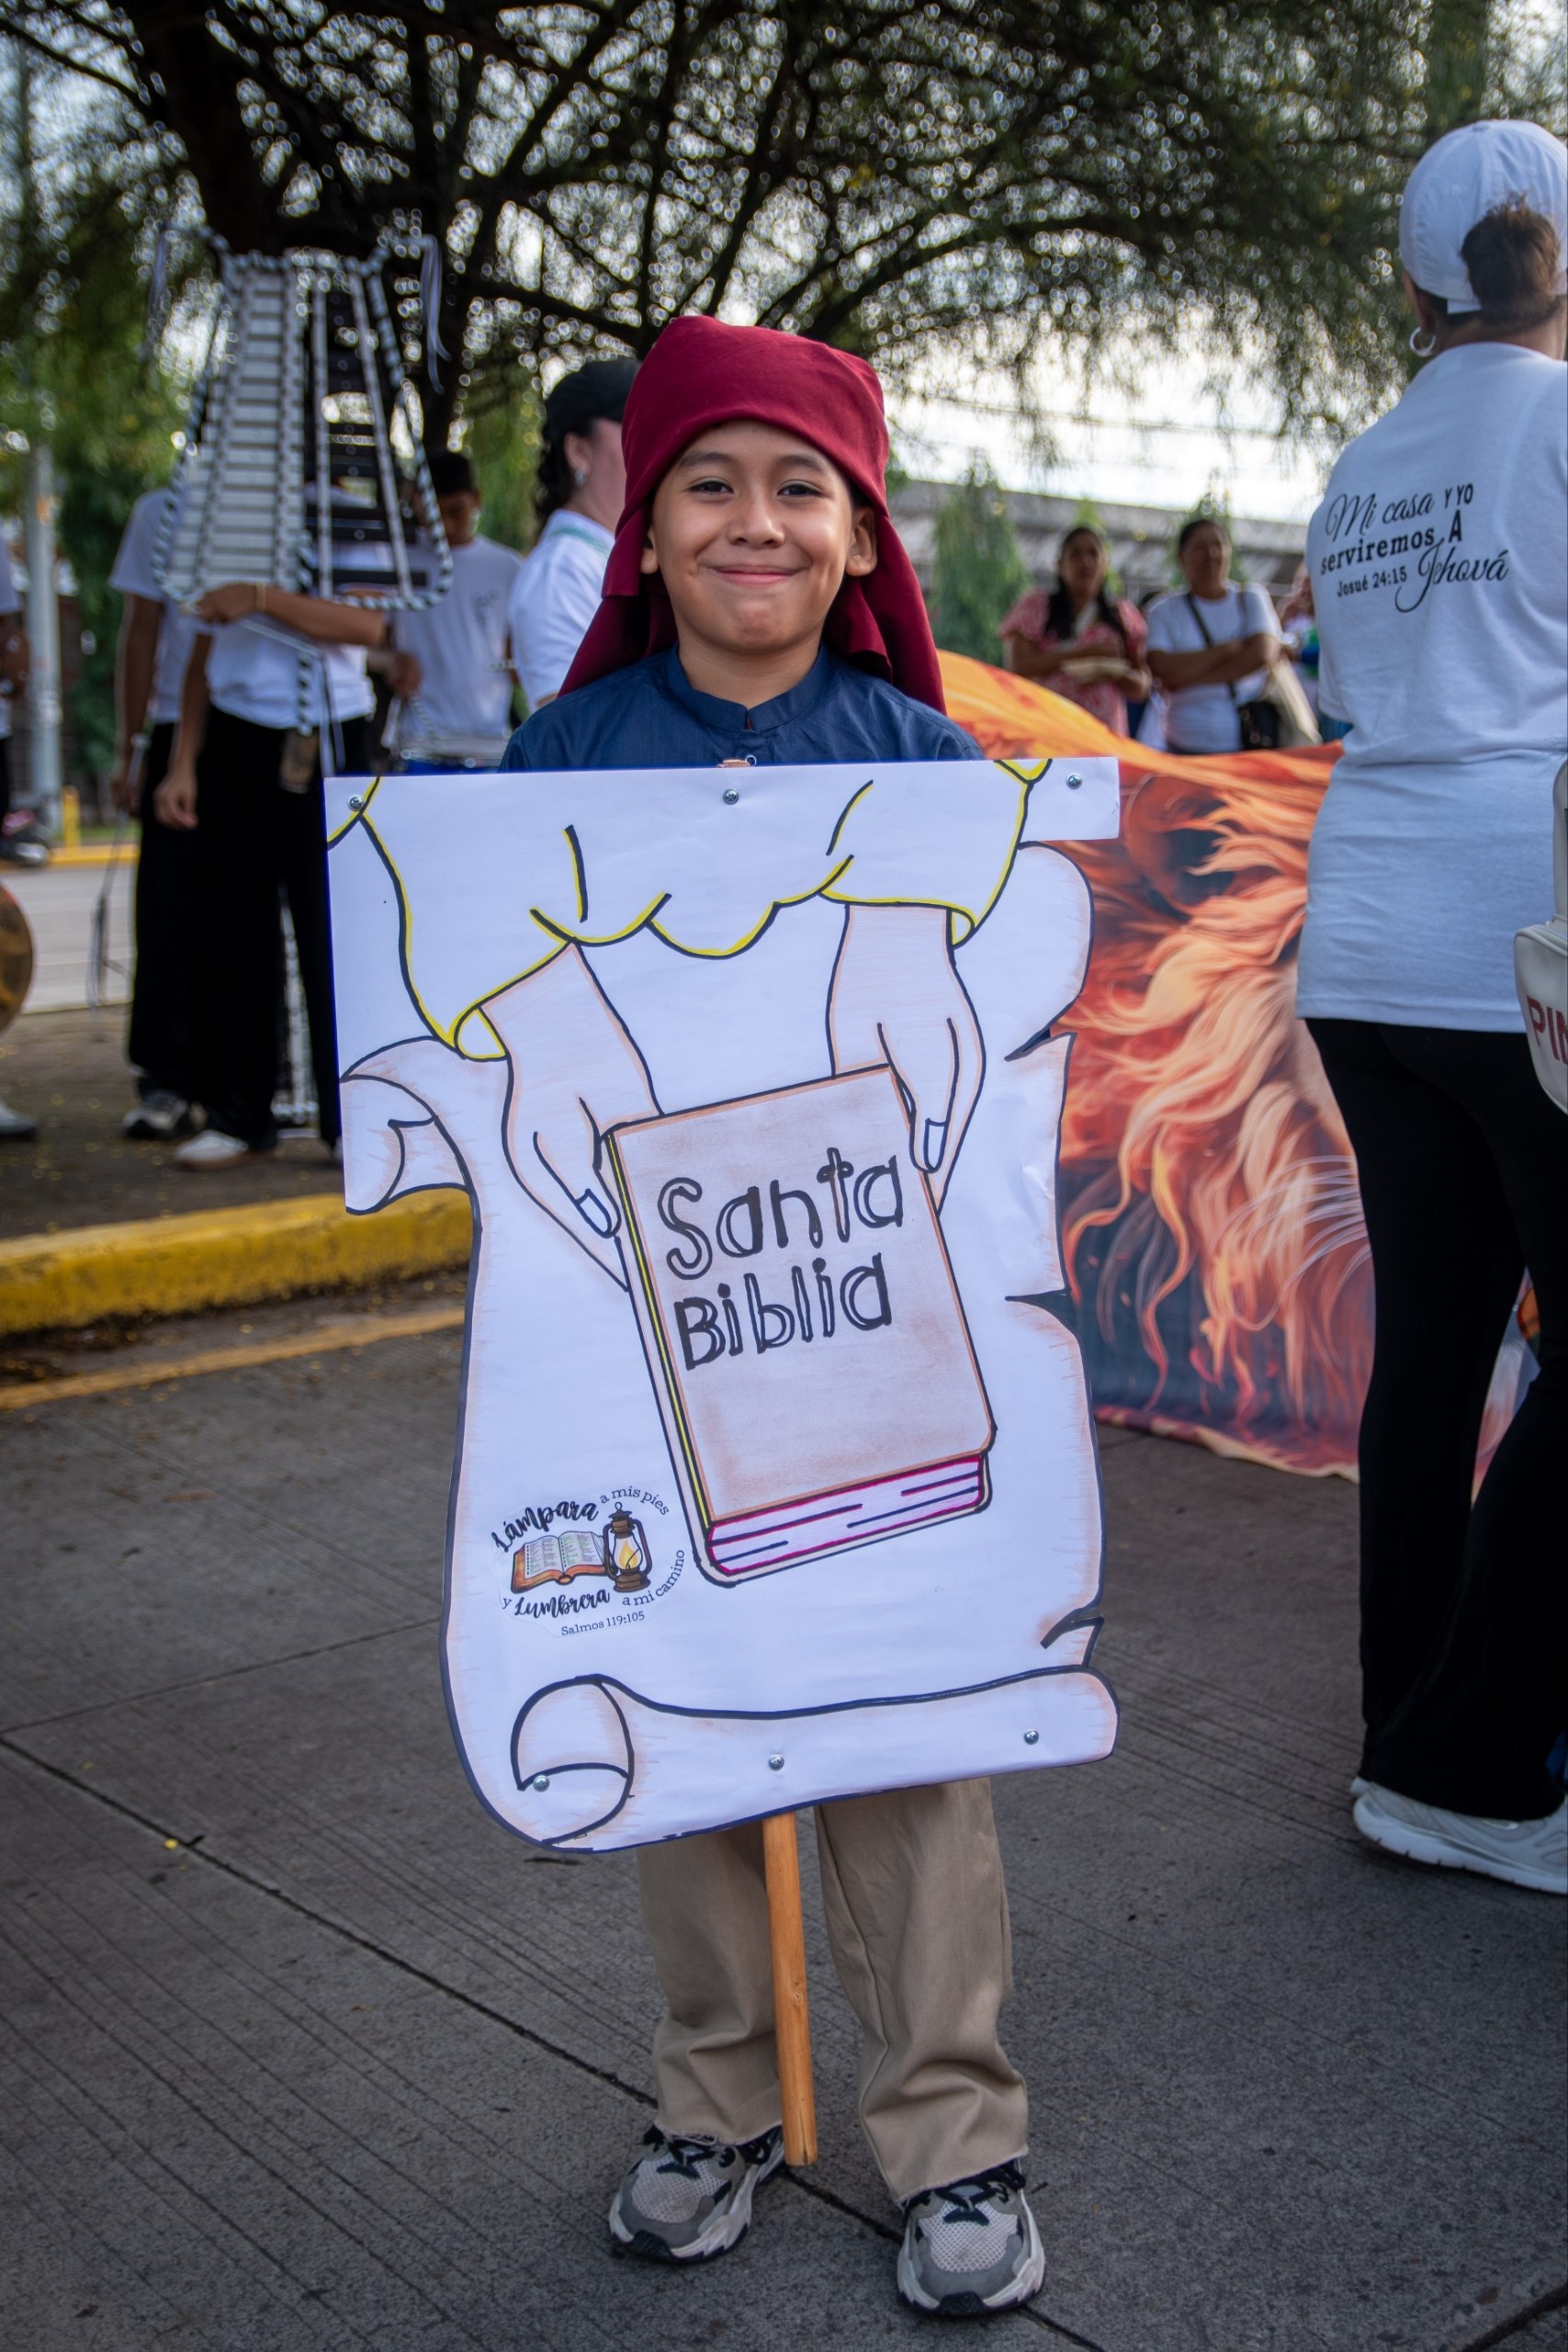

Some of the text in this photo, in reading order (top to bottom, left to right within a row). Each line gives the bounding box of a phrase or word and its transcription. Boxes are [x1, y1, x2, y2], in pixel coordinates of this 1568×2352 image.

[1320, 509, 1463, 575] serviremos A
[1325, 492, 1377, 542] Mi
[1382, 492, 1436, 525] casa
[1337, 565, 1407, 597] Josué 24:15
[1394, 537, 1510, 613] Jehová
[657, 1147, 904, 1280] Santa
[673, 1252, 893, 1371] Biblia
[599, 1495, 610, 1504] a
[611, 1485, 641, 1499] mis
[640, 1488, 670, 1516] pies
[502, 1549, 685, 1619] y Lumbrera a mi camino
[560, 1611, 645, 1636] Salmos 119:105
